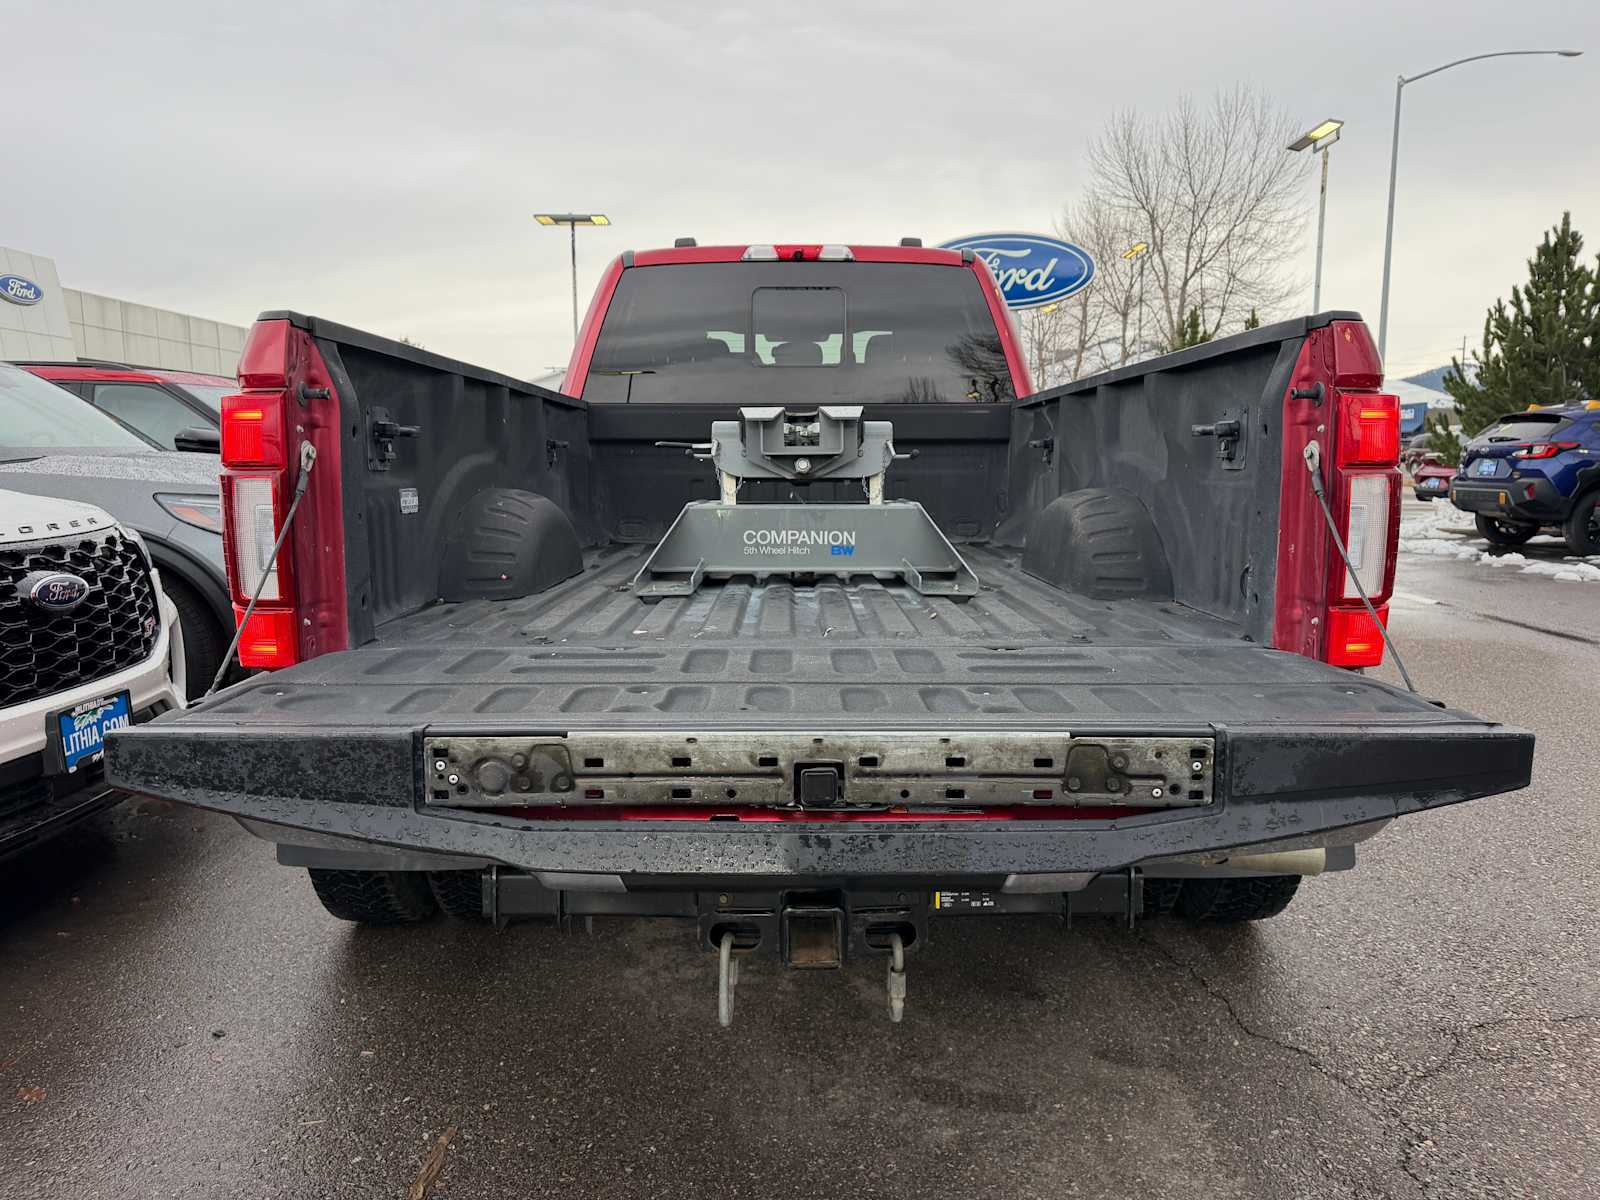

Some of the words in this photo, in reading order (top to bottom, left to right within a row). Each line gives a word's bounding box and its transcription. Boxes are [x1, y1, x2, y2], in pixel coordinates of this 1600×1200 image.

[8, 279, 36, 299] Ford
[0, 517, 98, 537] ORER
[743, 529, 856, 545] COMPANION
[743, 546, 757, 555] 5th
[760, 546, 786, 555] Wheel
[788, 546, 811, 555] Hitch
[46, 581, 80, 601] Ford
[63, 713, 129, 757] LITHIA.COM
